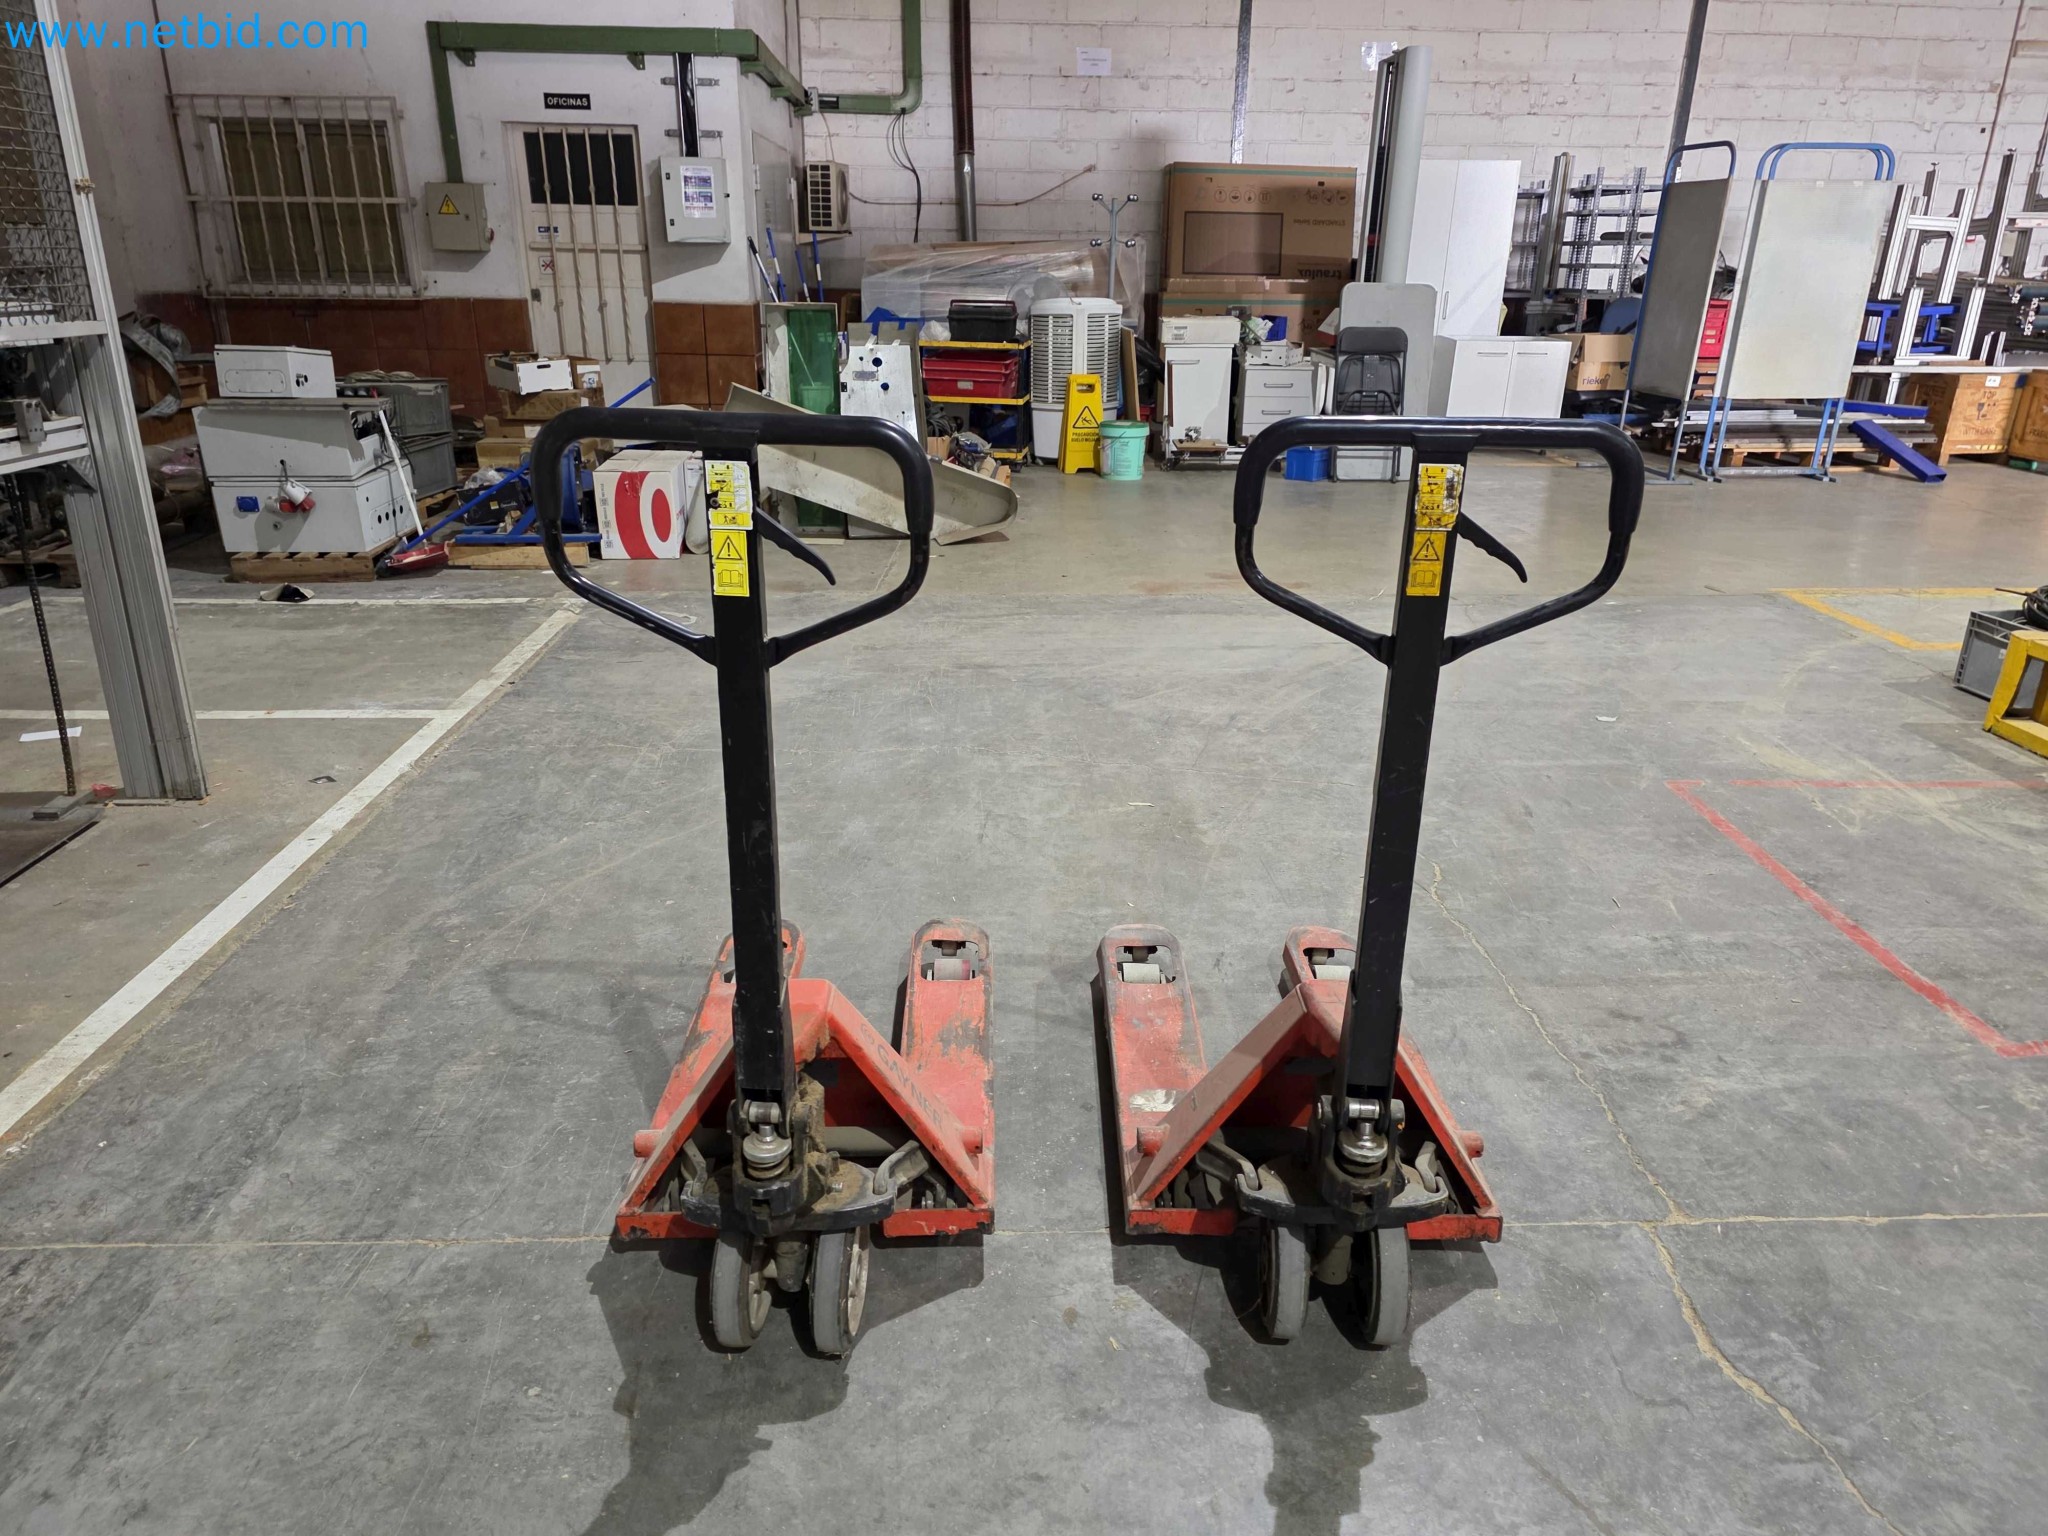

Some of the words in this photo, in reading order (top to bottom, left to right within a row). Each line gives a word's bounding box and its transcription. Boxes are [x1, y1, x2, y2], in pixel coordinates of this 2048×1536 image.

[547, 97, 588, 106] OFICINAS
[1312, 219, 1346, 227] STANDARD
[1297, 268, 1342, 280] traulux
